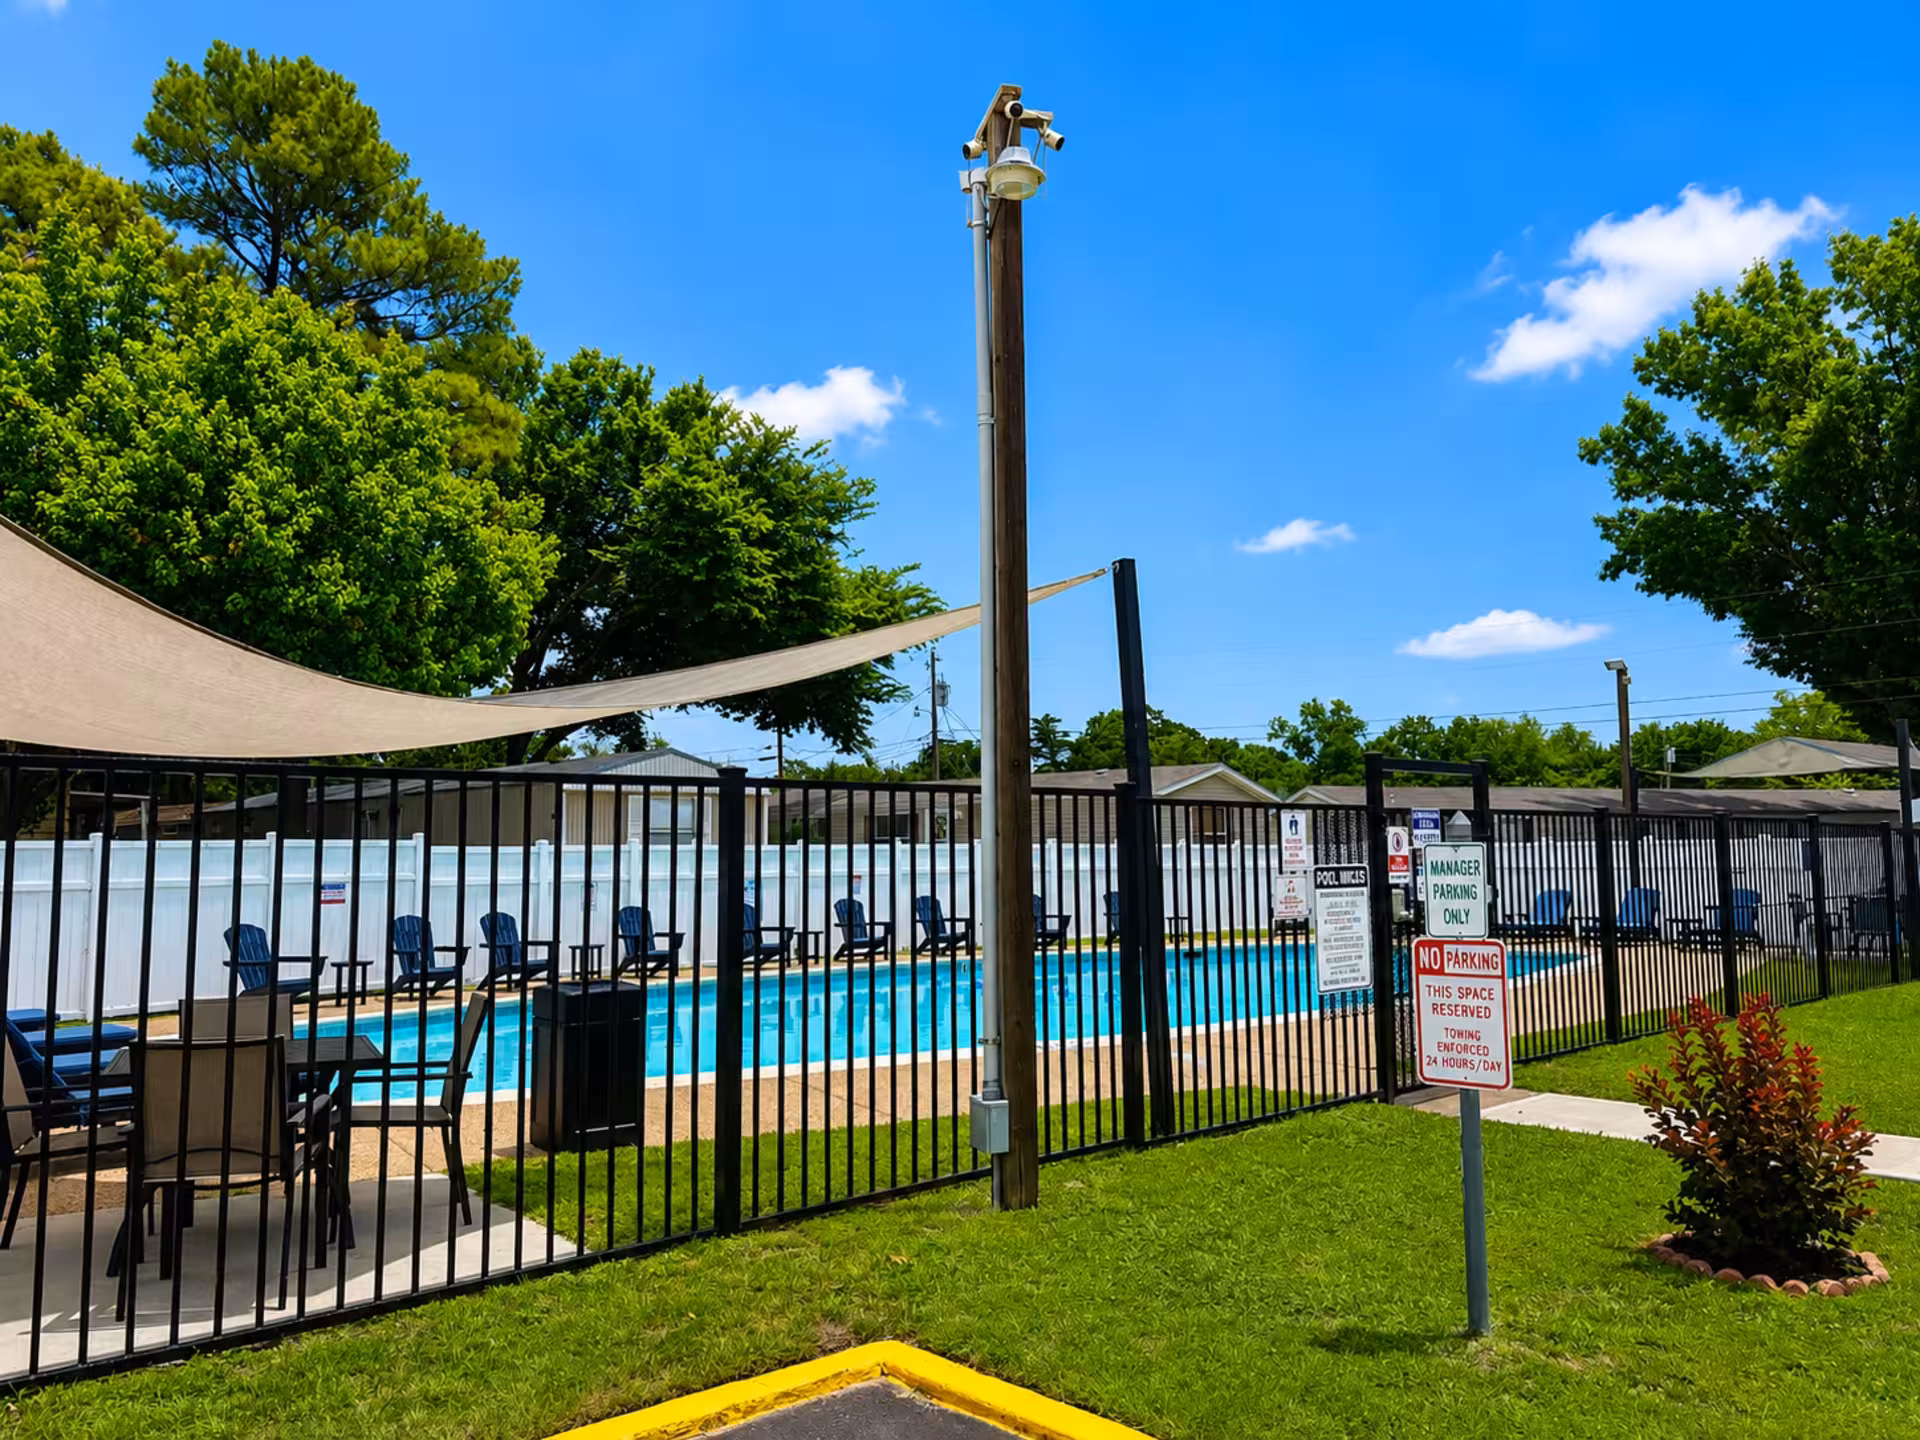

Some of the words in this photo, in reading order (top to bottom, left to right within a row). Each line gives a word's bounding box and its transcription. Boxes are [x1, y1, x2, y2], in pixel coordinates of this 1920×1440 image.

[1430, 859, 1481, 876] MANAGER
[1433, 883, 1478, 900] PARKING
[1443, 907, 1470, 925] ONLY
[1419, 946, 1441, 970] NO
[1446, 951, 1499, 971] PARKING
[1425, 984, 1453, 999] THIS
[1457, 986, 1495, 1001] SPACE
[1431, 1003, 1492, 1019] RESERVED
[1443, 1027, 1481, 1042] TOWING
[1437, 1041, 1490, 1057] ENFORCED
[1426, 1055, 1438, 1067] 24
[1442, 1056, 1503, 1073] HOURS/DAY
